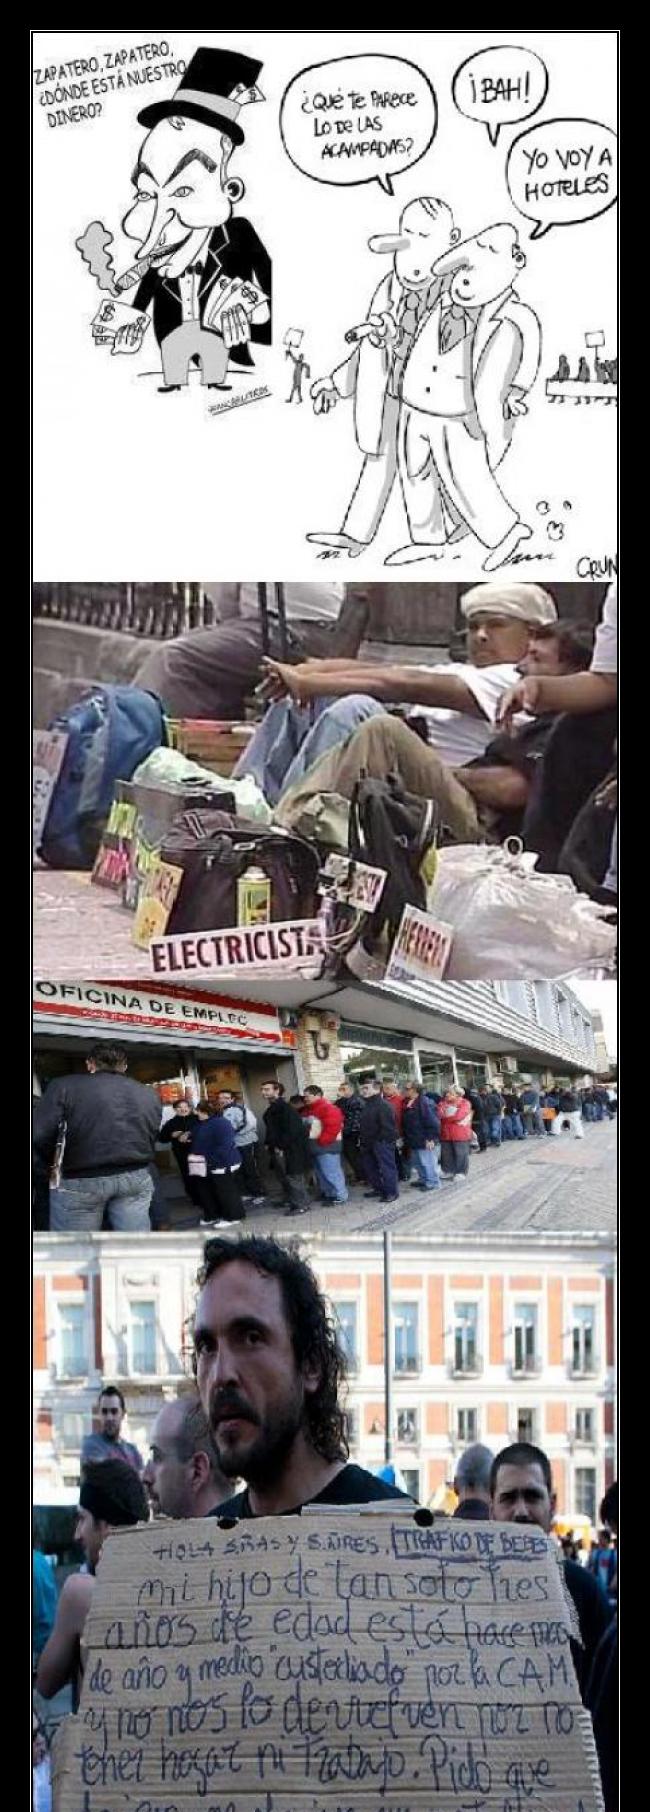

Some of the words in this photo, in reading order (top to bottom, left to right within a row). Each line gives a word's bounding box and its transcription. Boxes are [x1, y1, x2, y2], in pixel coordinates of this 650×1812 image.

[33, 56, 103, 85] ZAPATERO,
[104, 41, 174, 69] ZAPATERO,
[40, 81, 89, 107] ¿DÓNDE
[91, 70, 124, 95] ESTÁ
[126, 60, 187, 86] NUESTRO
[468, 71, 530, 104] ¡BAH!
[47, 102, 103, 128] DINERO?
[313, 117, 331, 138] LO
[357, 116, 383, 134] LAS
[321, 137, 414, 160] ACAMPADAS?
[522, 148, 548, 175] YO
[555, 145, 593, 171] VOY
[597, 148, 613, 167] A
[35, 981, 142, 1010] OFICINA
[149, 1001, 176, 1015] DE
[154, 1542, 214, 1560] HOLA
[500, 1532, 550, 1553] BEBES
[138, 1572, 194, 1606] mi
[208, 1569, 272, 1610] hijo
[284, 1553, 319, 1599] de
[105, 1609, 198, 1650] años
[211, 1599, 253, 1644] de
[273, 1600, 358, 1645] edad
[367, 1603, 456, 1650] está
[461, 1603, 525, 1650] hace
[89, 1658, 112, 1694] de
[122, 1656, 167, 1690] año
[176, 1661, 192, 1704] y
[200, 1644, 264, 1681] medio
[424, 1663, 465, 1704] por
[470, 1646, 490, 1689] la
[83, 1707, 108, 1747] y
[117, 1706, 158, 1740] no
[168, 1692, 228, 1736] nos
[241, 1681, 274, 1729] lo
[479, 1702, 530, 1755] por
[543, 1701, 575, 1735] no
[78, 1744, 146, 1785] tener
[161, 1738, 242, 1796] hogar
[257, 1733, 286, 1778] ni
[420, 1734, 491, 1794] Pido
[505, 1757, 557, 1806] que
